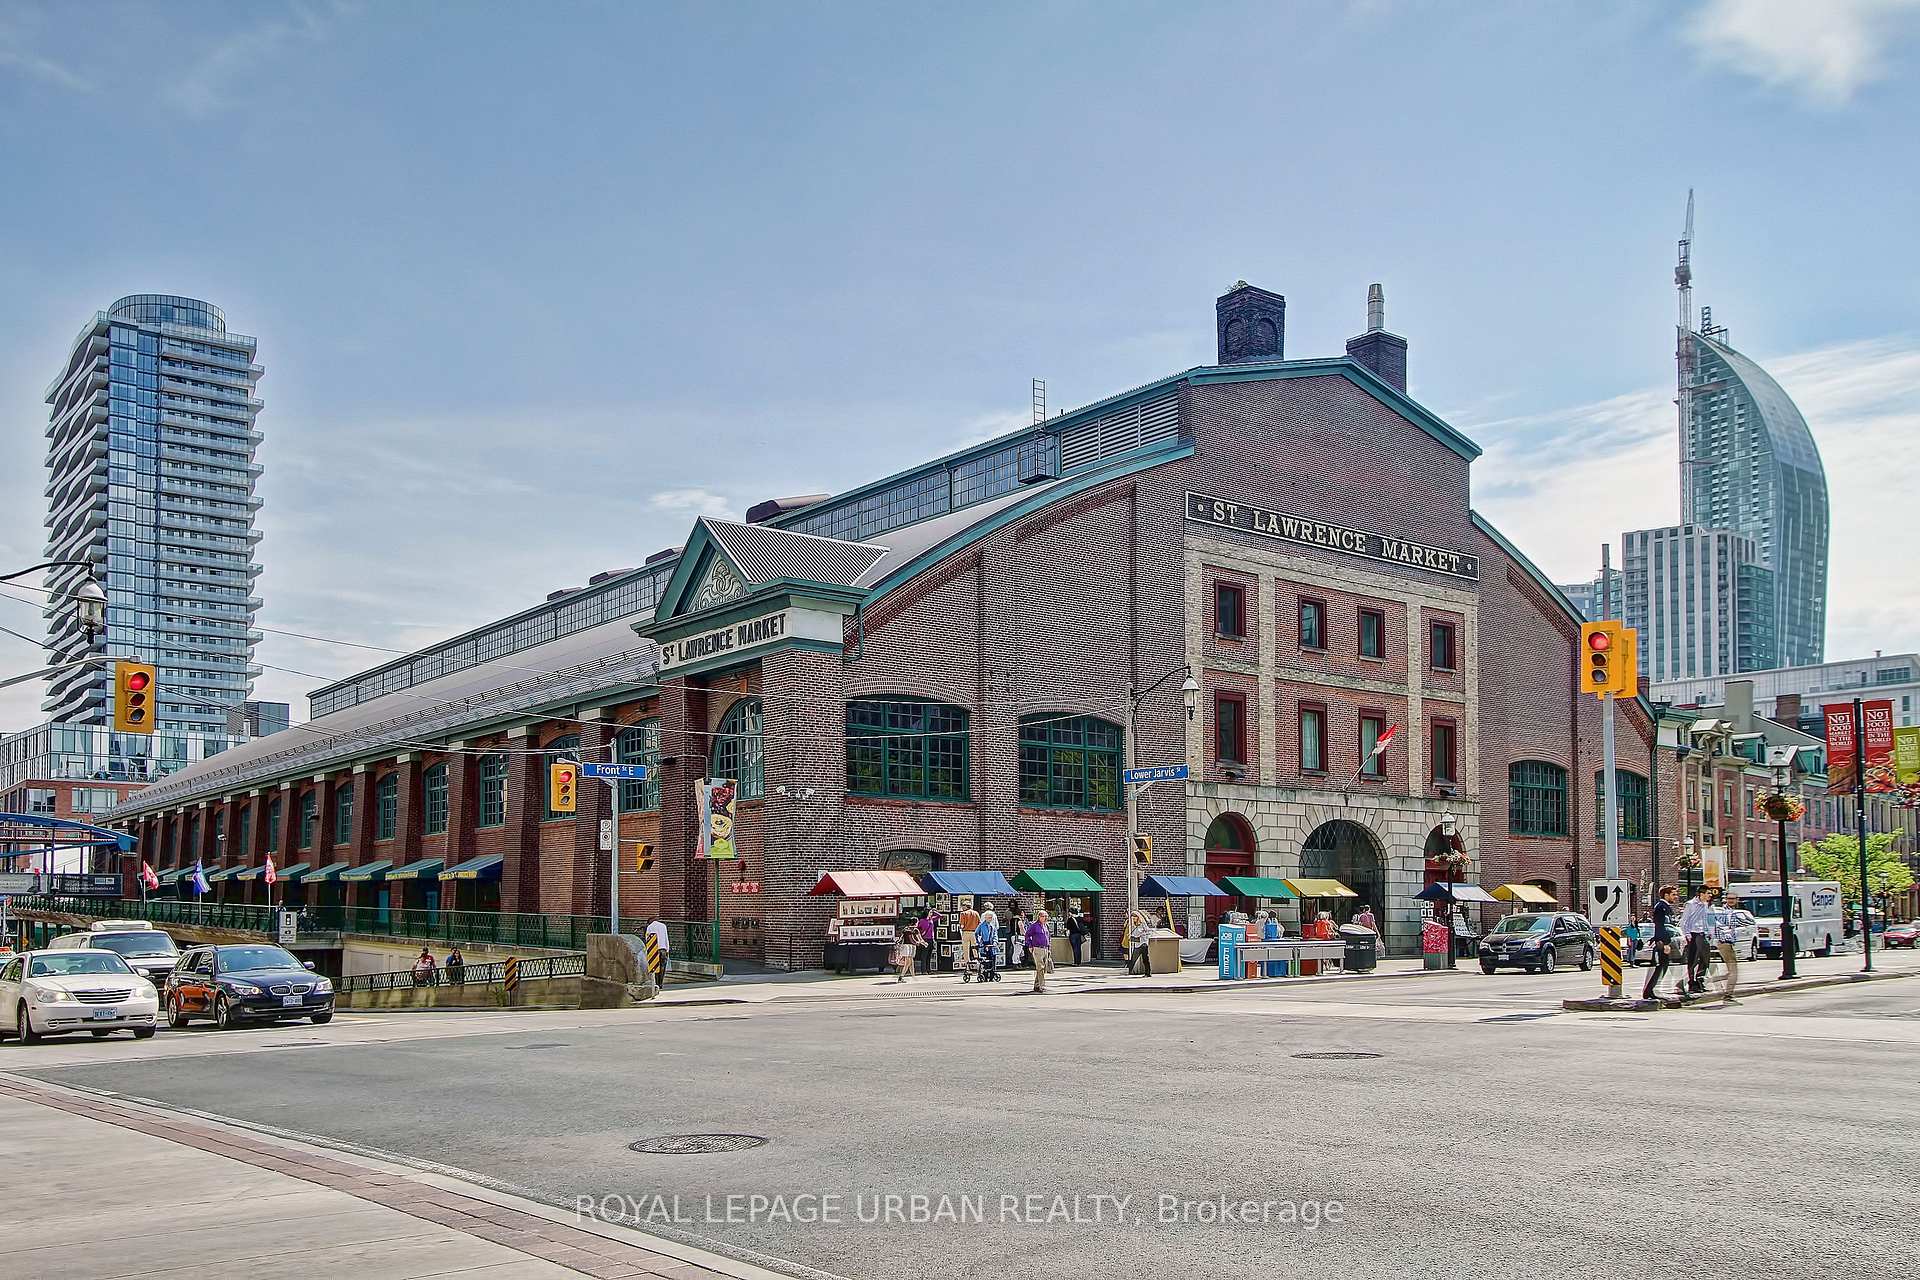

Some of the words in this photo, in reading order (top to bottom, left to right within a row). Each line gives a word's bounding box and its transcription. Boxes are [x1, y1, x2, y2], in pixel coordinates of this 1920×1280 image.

[1253, 510, 1366, 552] LAWRENCE
[1381, 539, 1460, 572] MARKET
[678, 629, 734, 662] LAWRENCE
[737, 613, 786, 646] MARKET
[596, 765, 620, 775] Front
[628, 767, 634, 776] E
[1130, 770, 1152, 779] Lower
[1153, 767, 1175, 778] Jarvis
[1811, 891, 1836, 907] Canpar
